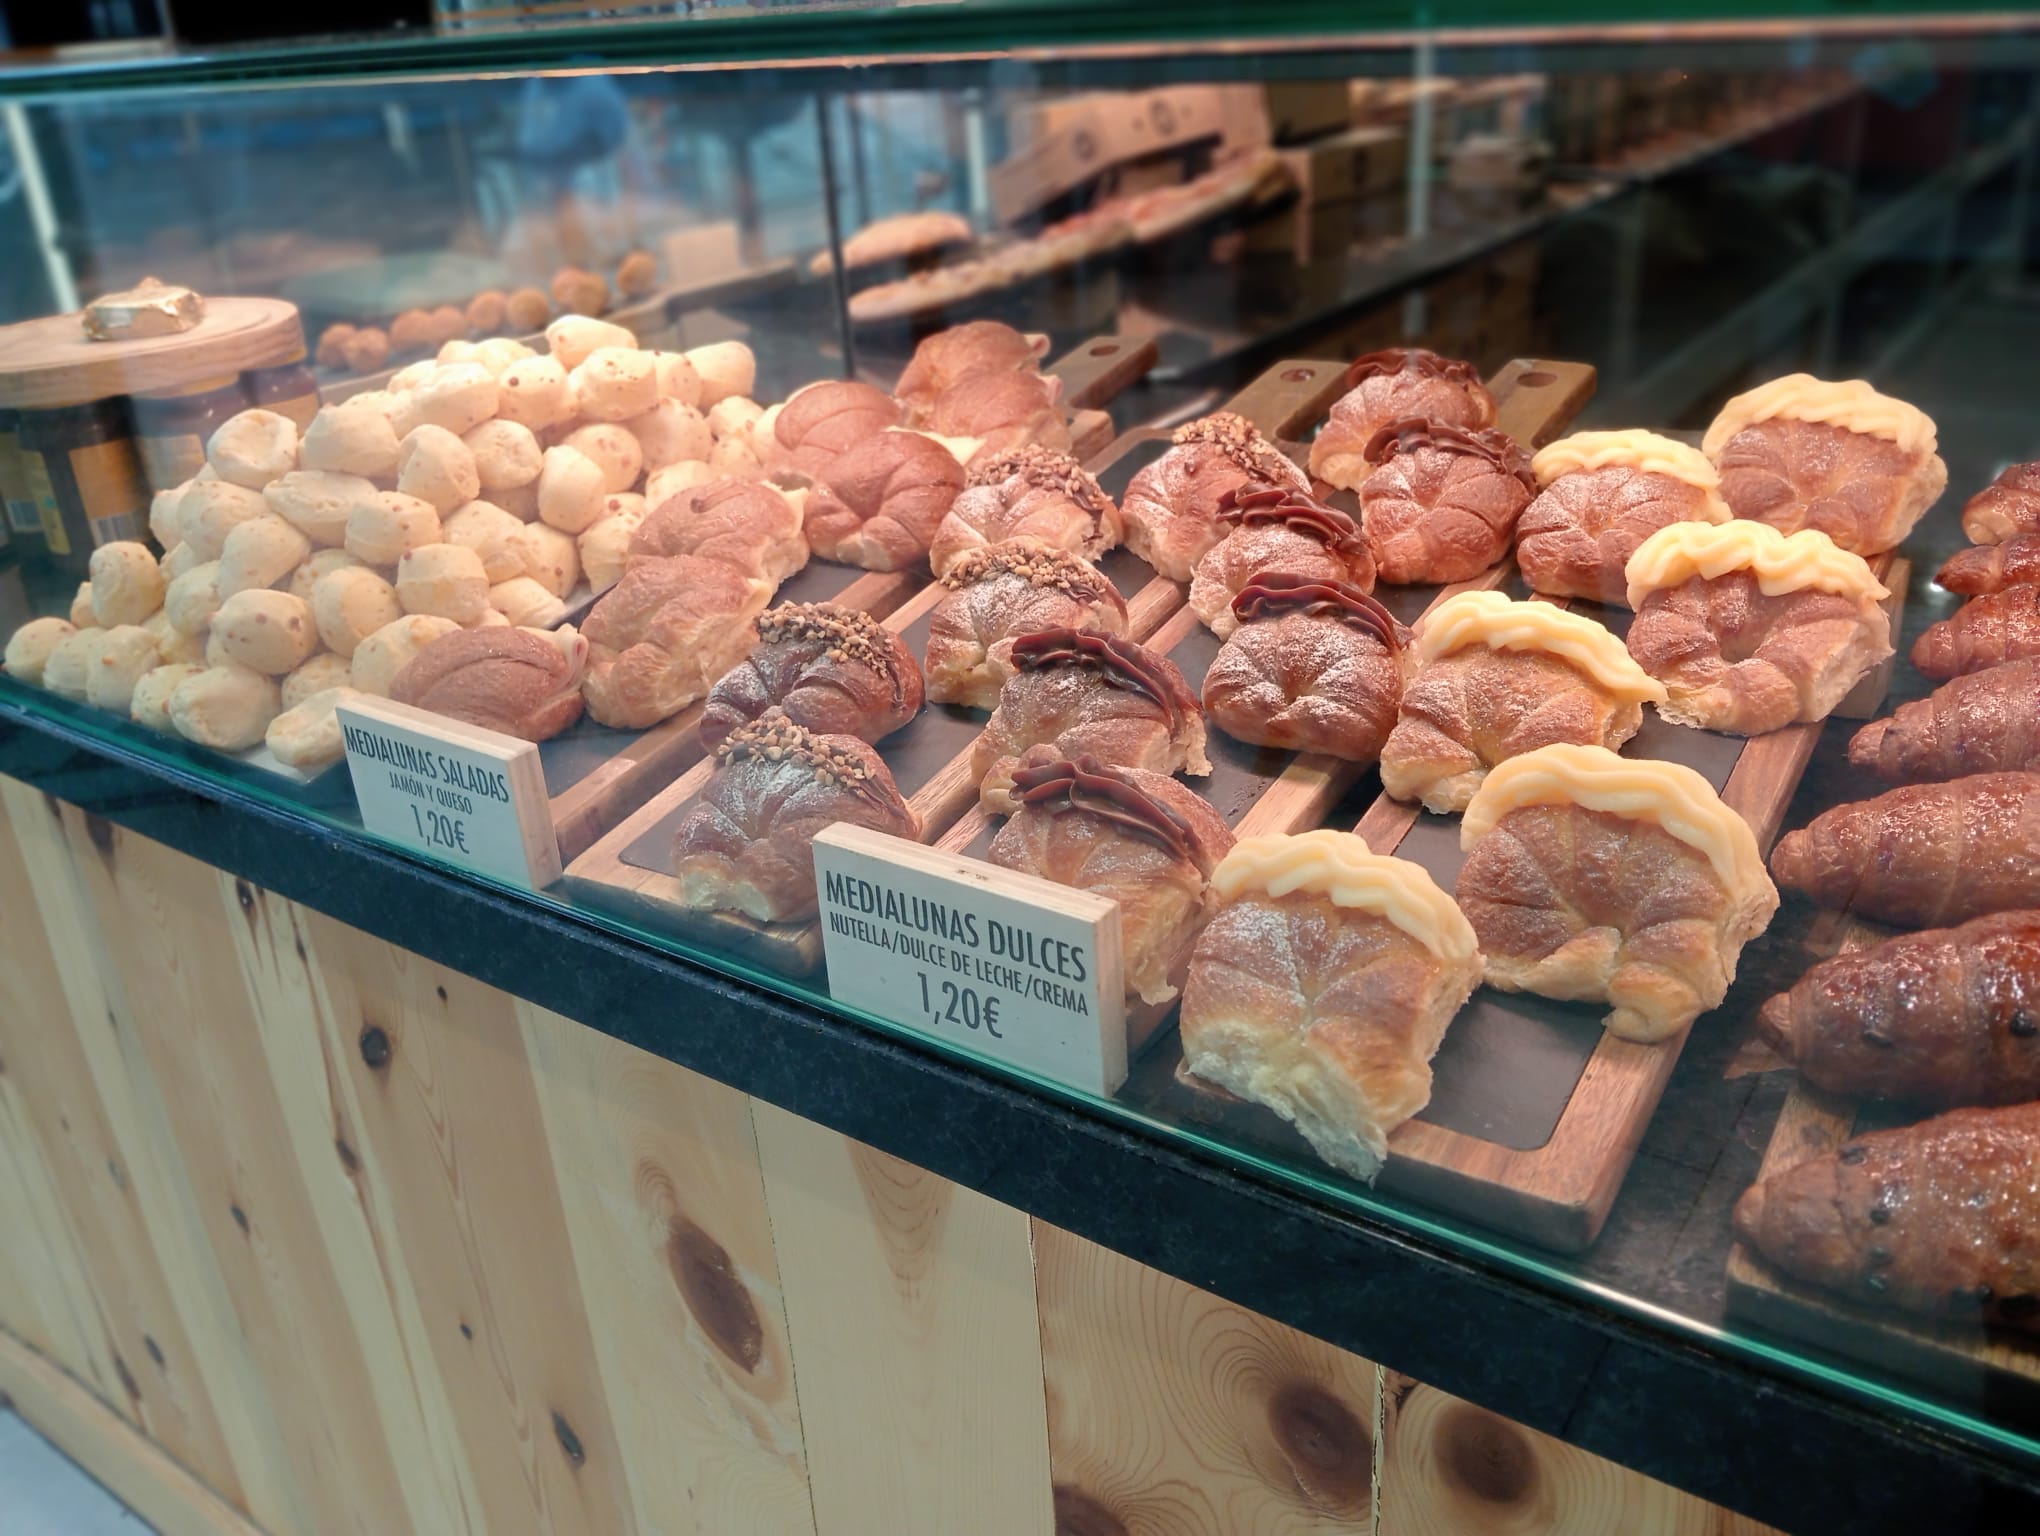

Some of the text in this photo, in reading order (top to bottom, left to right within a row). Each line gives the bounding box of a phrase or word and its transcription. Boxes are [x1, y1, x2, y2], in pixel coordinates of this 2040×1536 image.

[344, 724, 509, 803] MEDIALUNAS SALADAS
[389, 771, 473, 815] JAMÓN Y QUESO
[411, 804, 470, 854] 1,20€
[826, 870, 1087, 983] MEDIALUNAS DULCES
[830, 911, 1089, 1016] NUTELLA/DULCE DE LECHE/CREMA
[917, 971, 1003, 1039] 1,20€
